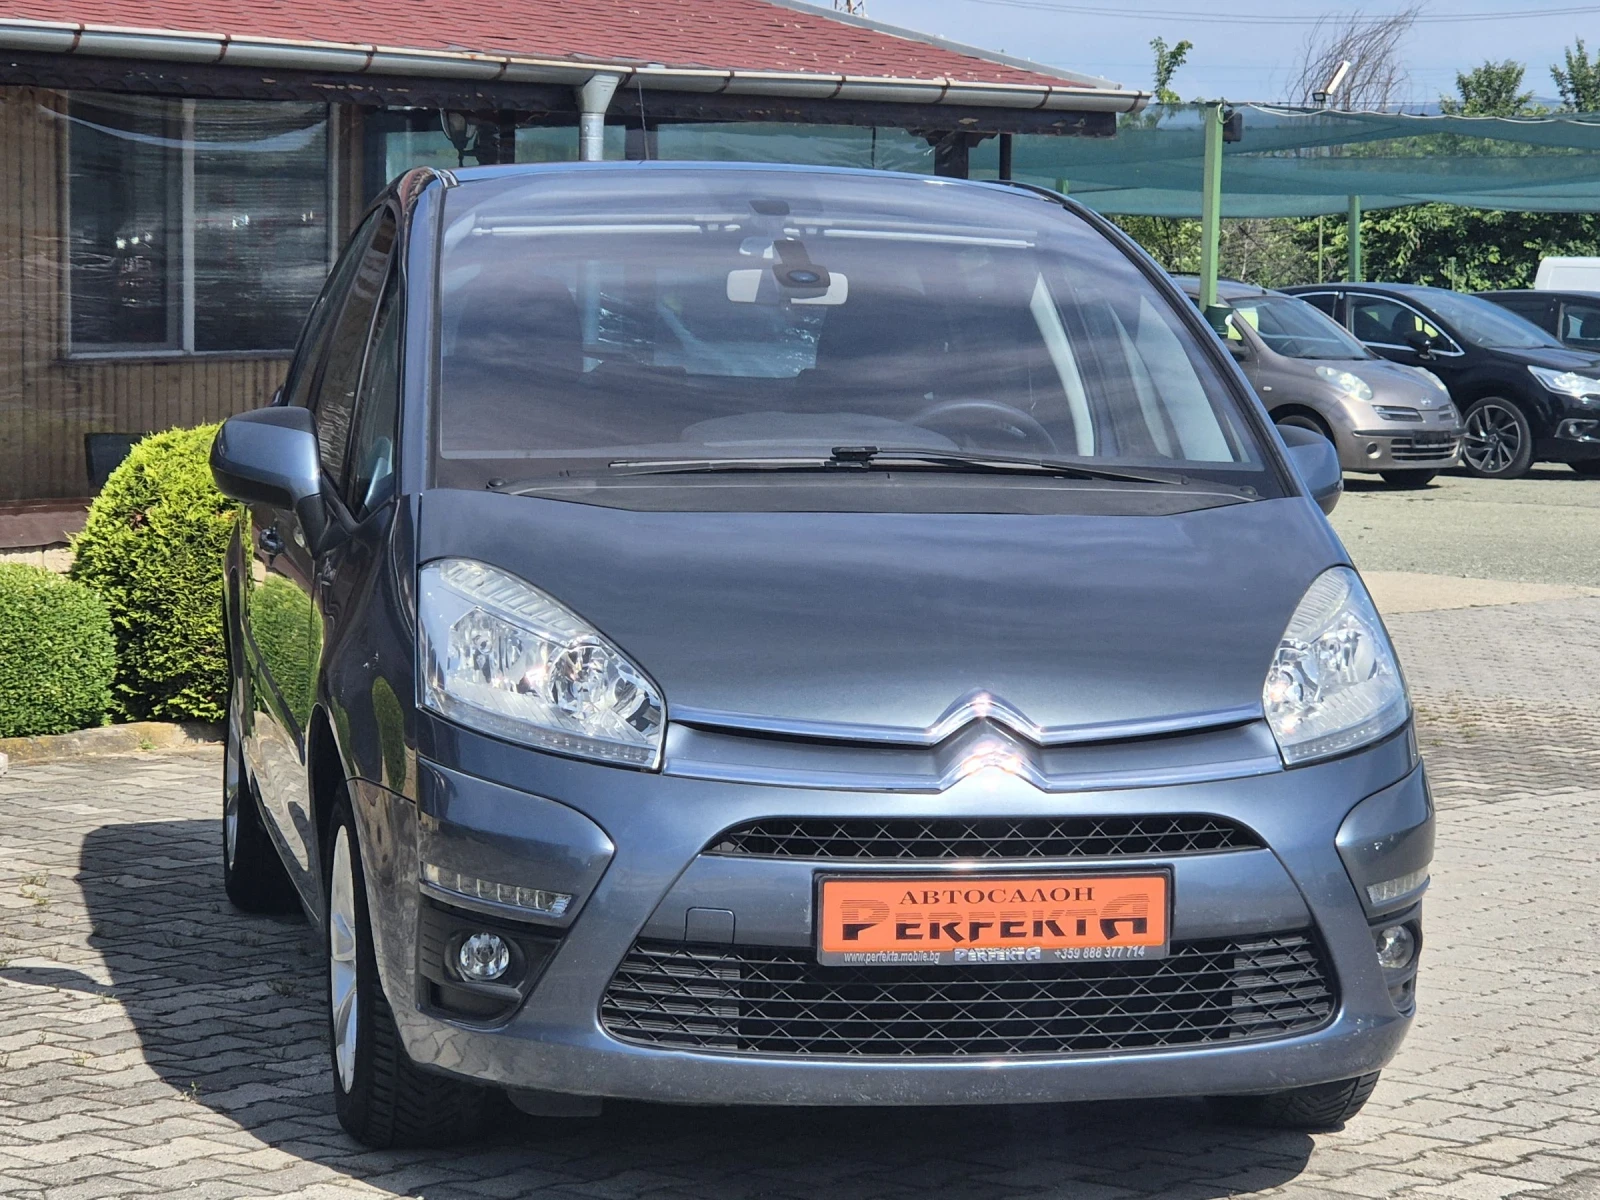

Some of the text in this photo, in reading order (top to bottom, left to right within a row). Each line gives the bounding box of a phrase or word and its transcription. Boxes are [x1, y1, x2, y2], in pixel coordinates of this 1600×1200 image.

[899, 886, 1096, 906] АВТОСАЛОН
[839, 893, 1151, 943] PERFEKTA
[843, 950, 941, 964] www.perfekta.mobile.bg
[1054, 945, 1146, 960] +359 888 377 714
